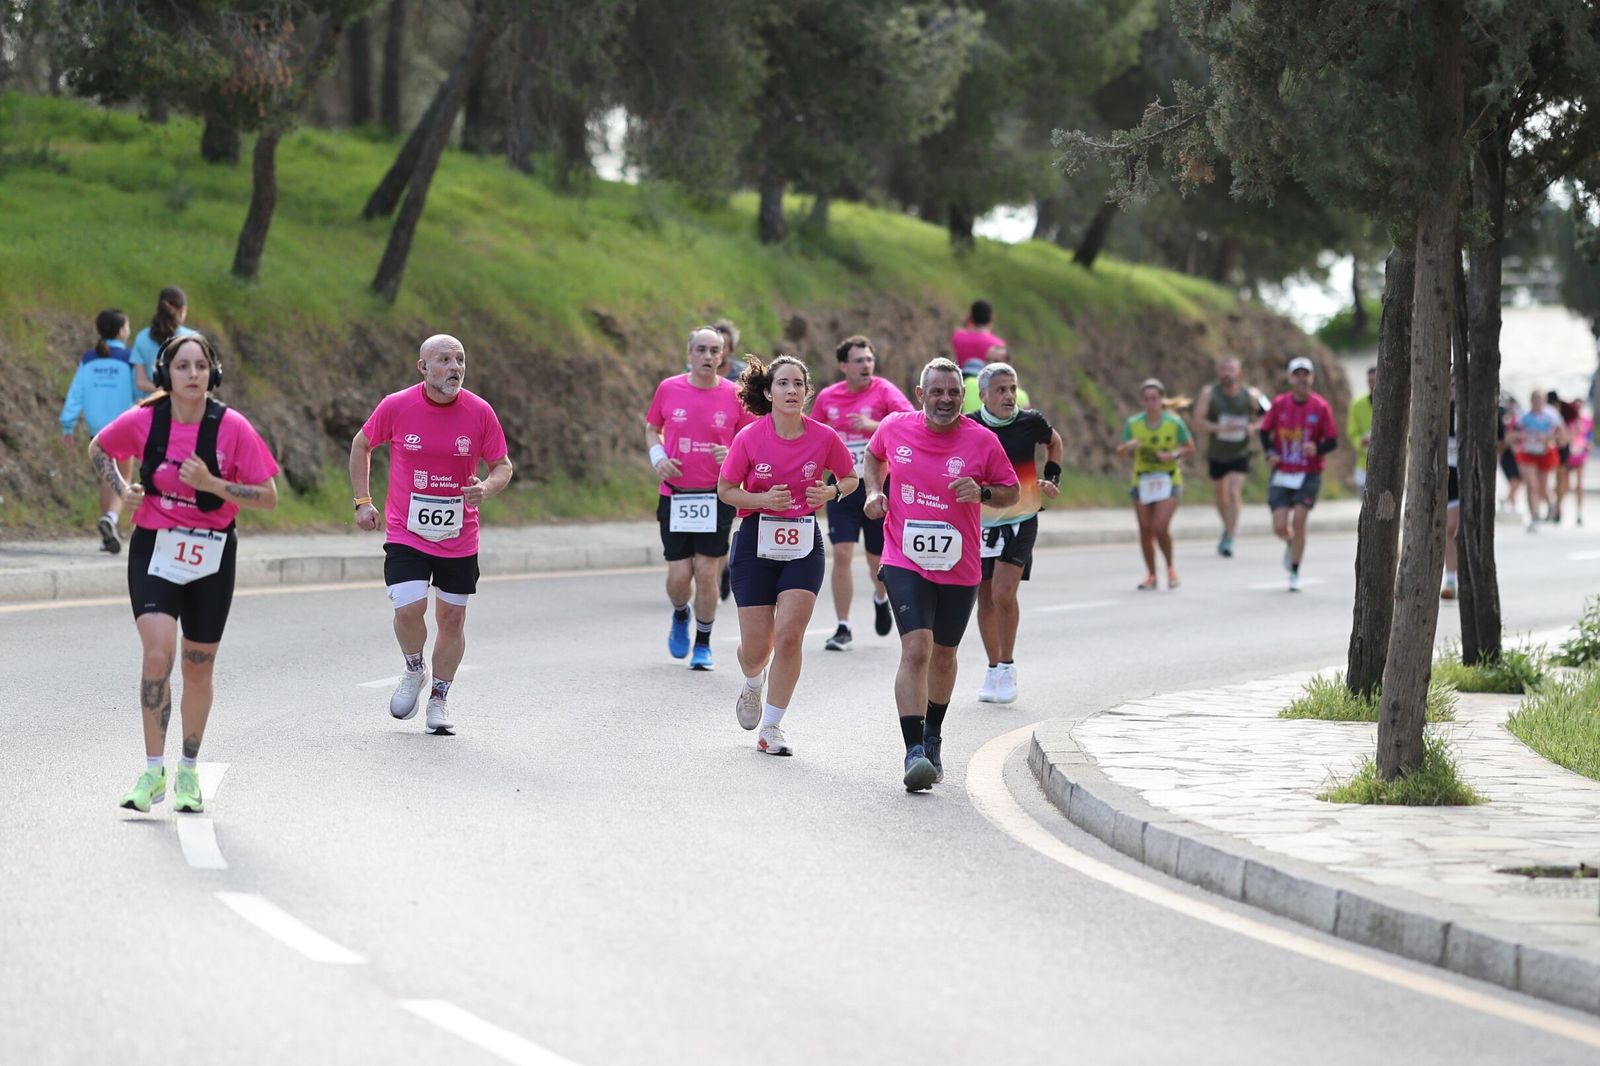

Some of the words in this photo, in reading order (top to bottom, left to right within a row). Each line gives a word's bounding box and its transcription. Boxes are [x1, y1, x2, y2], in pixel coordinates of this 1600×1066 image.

[917, 491, 940, 502] Ciudad
[418, 508, 455, 526] 662
[679, 504, 710, 519] 550
[774, 528, 800, 546] 68
[912, 534, 953, 553] 617
[174, 540, 204, 566] 15
